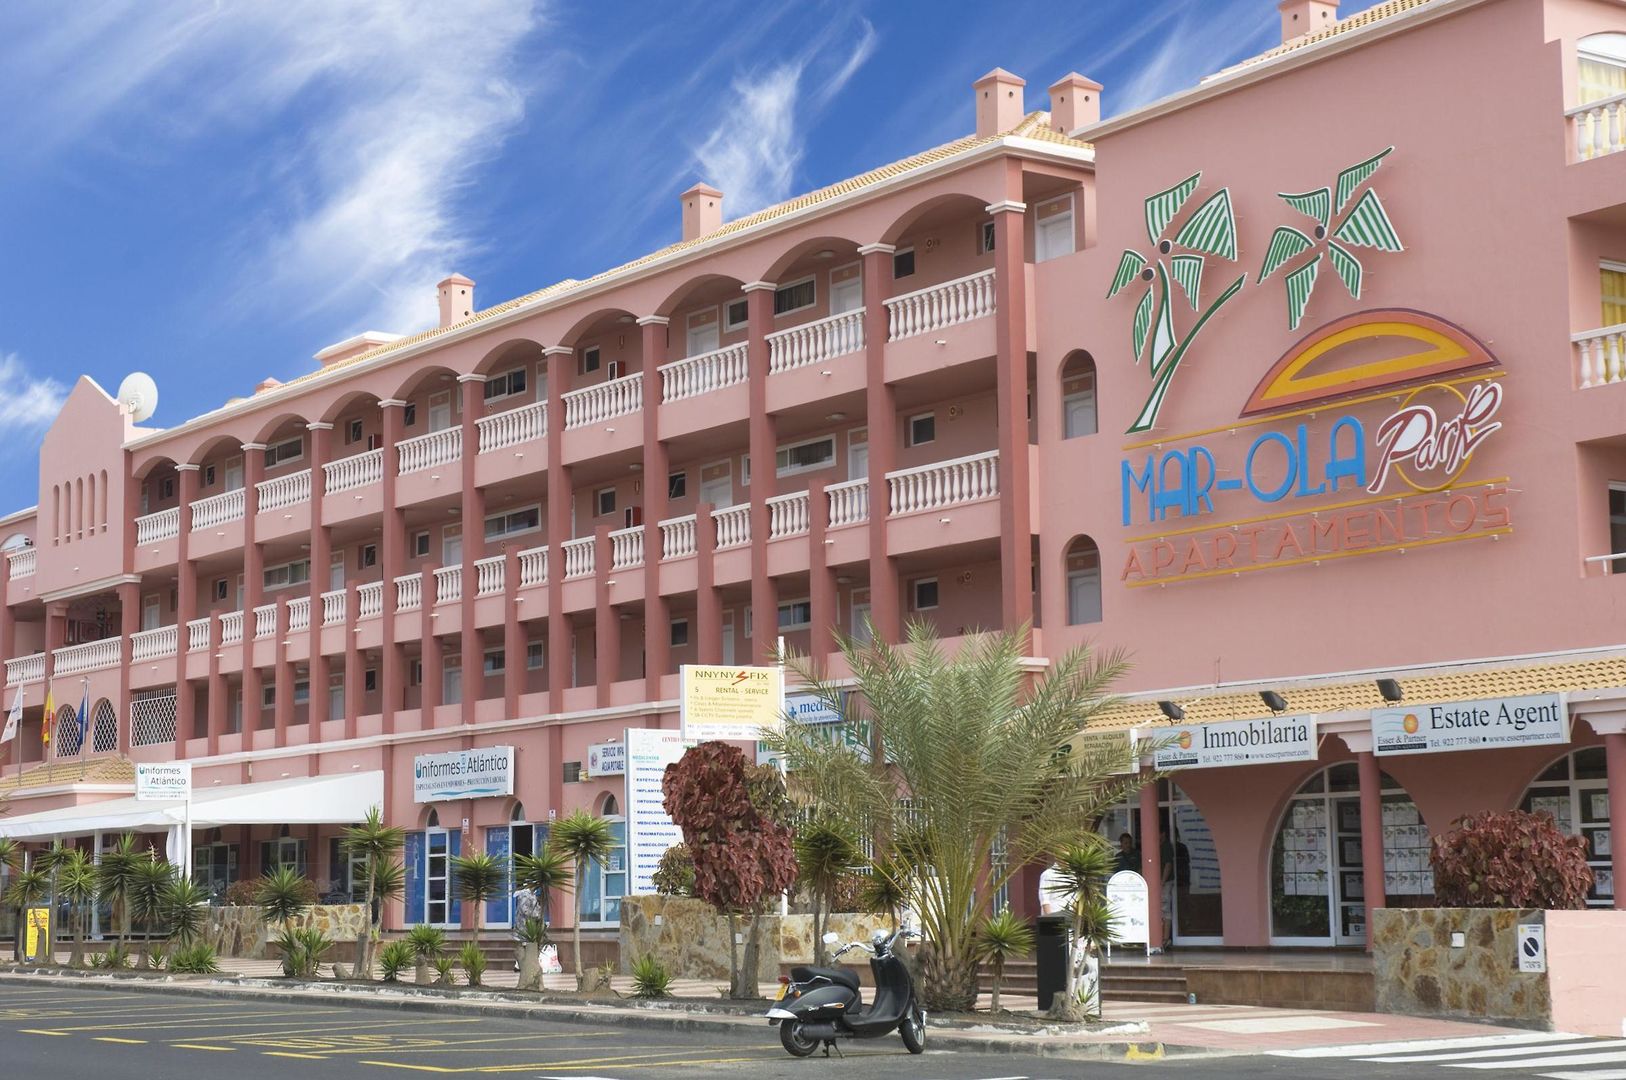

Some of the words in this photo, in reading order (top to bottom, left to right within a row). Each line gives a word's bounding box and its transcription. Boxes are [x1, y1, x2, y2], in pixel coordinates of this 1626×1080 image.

[1121, 414, 1366, 527] MAR-OLA
[1366, 382, 1503, 495] Park
[1121, 487, 1511, 582] APARTAMENTOS
[1430, 706, 1490, 730] Estate
[1496, 701, 1560, 731] Agent
[1202, 718, 1308, 749] Inmobilaria
[1377, 736, 1395, 745] Esser
[1395, 736, 1403, 744] &
[1403, 734, 1427, 744] Partner
[1430, 740, 1441, 748] Tel.
[1442, 738, 1454, 746] 922
[1488, 731, 1561, 744] www.esserpartner.com
[415, 760, 460, 778] Uniformes
[467, 753, 508, 774] Atlántico
[1157, 752, 1171, 761] Esser
[1172, 752, 1179, 760] &
[1179, 750, 1198, 760] Partner
[139, 766, 181, 775] Uniformes
[151, 776, 186, 785] Atlántico
